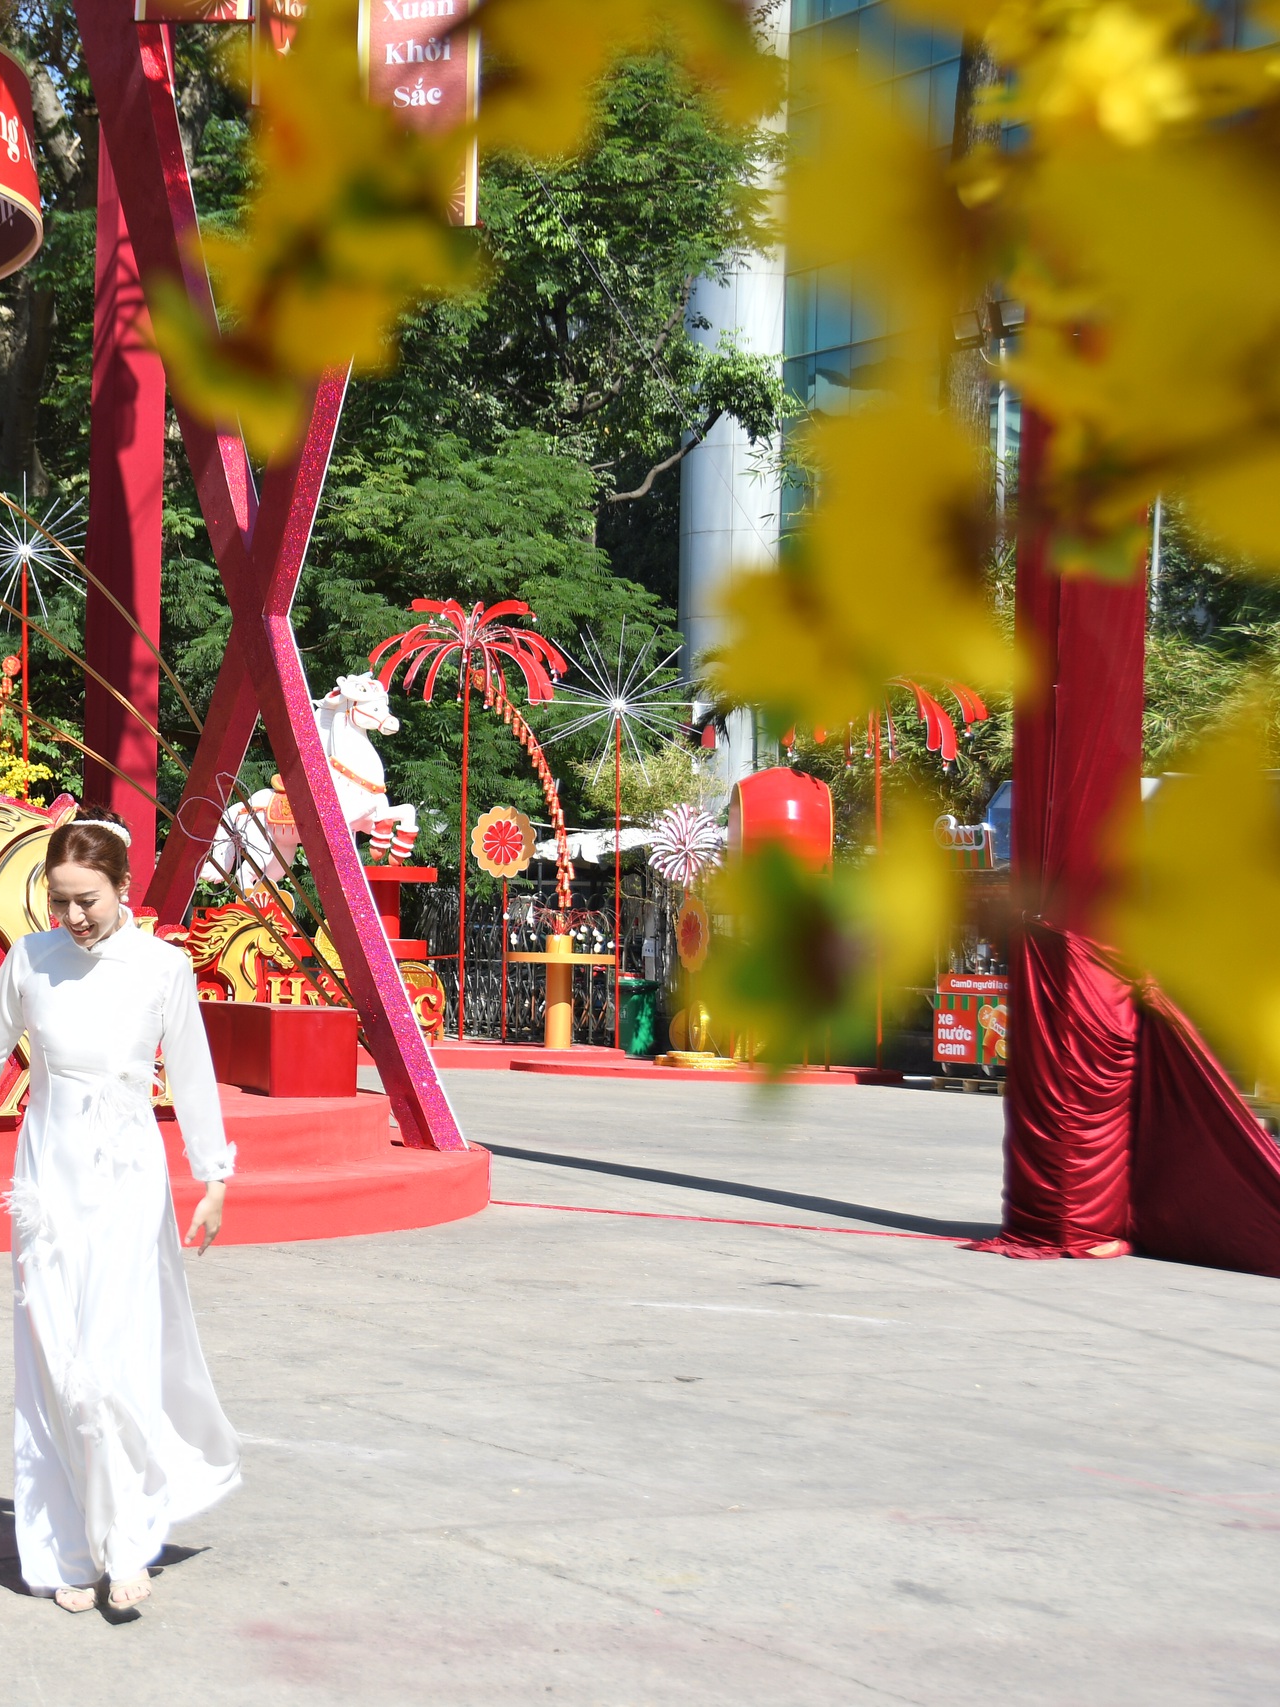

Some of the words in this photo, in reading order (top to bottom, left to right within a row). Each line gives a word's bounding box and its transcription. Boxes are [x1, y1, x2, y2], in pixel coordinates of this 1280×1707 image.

[385, 37, 451, 65] Khởi
[393, 78, 442, 108] Sắc
[950, 978, 972, 988] CamD
[972, 980, 995, 990] người
[937, 1013, 954, 1025] xe
[937, 1024, 972, 1041] nước
[937, 1042, 965, 1055] cam
